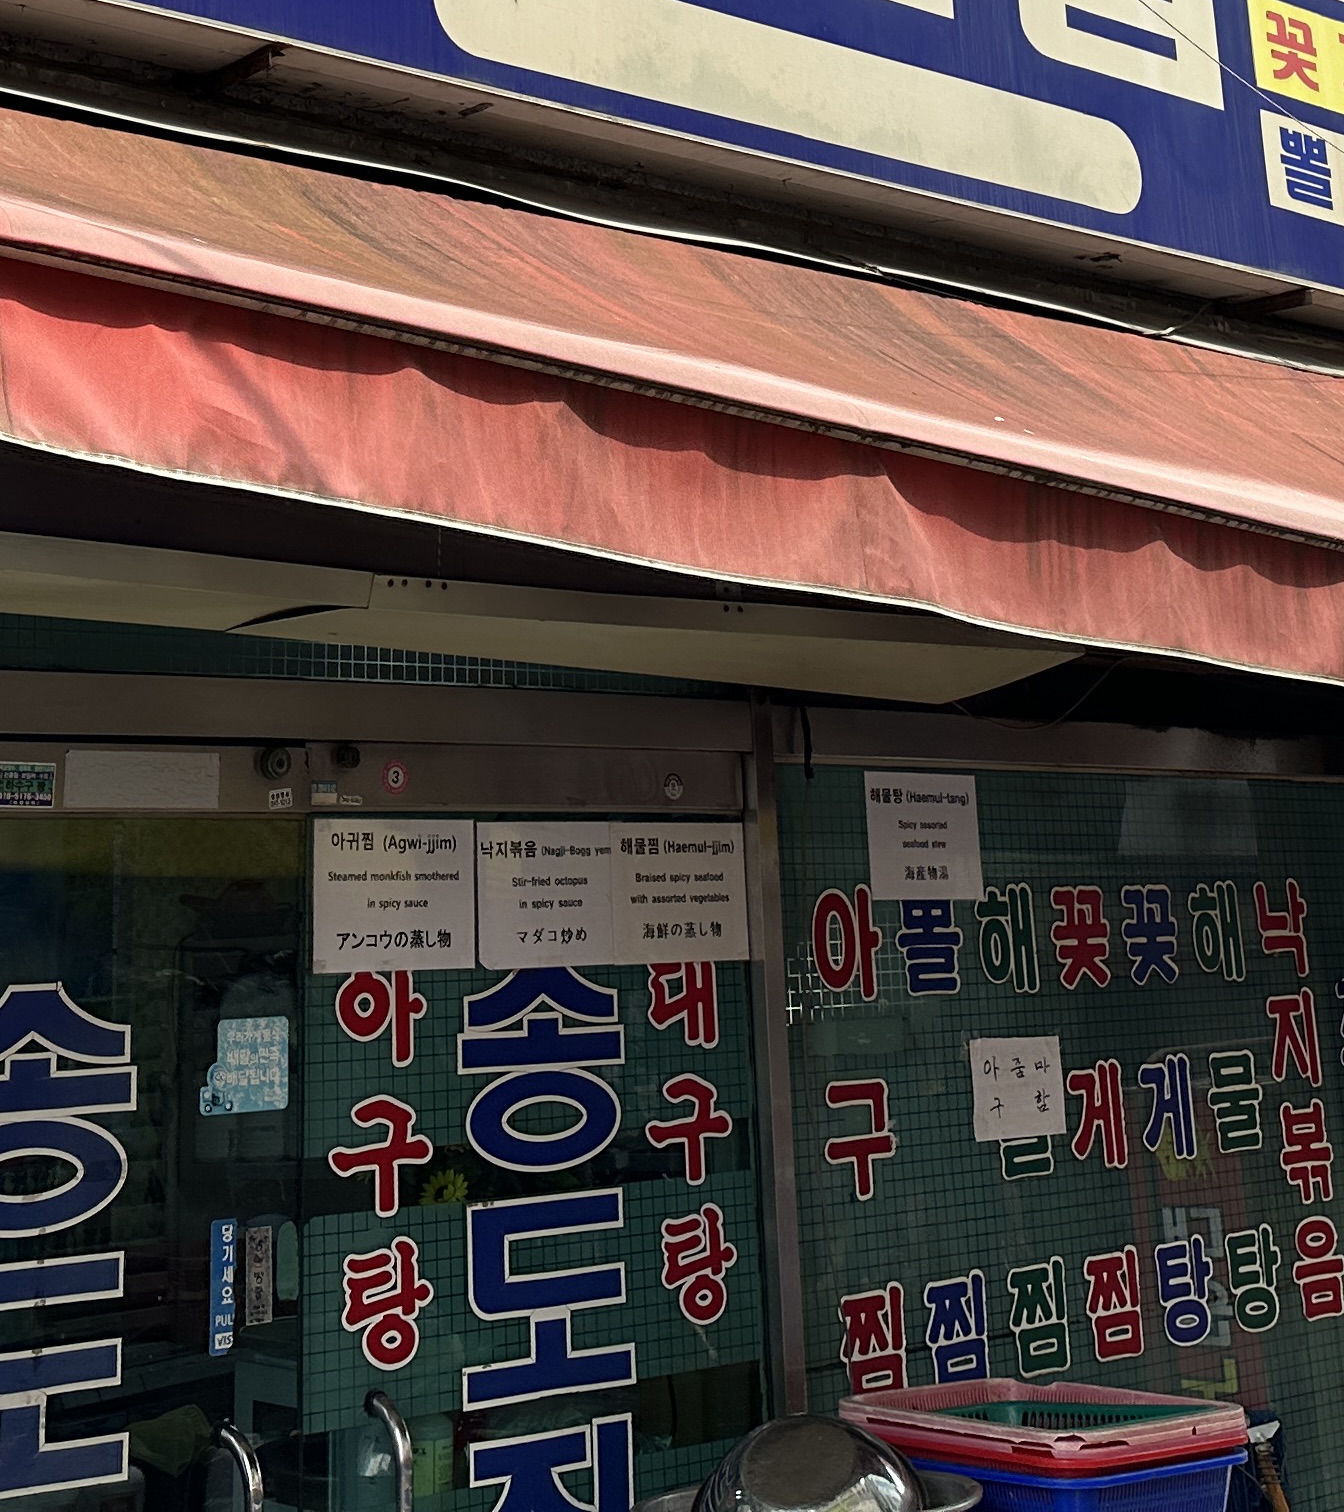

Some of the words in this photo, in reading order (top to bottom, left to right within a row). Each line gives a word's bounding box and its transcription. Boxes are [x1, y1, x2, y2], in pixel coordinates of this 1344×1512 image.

[331, 831, 374, 851] 아귀찜
[383, 834, 457, 854] (Agwi-jjim)
[480, 840, 537, 860] 낙지볶음
[620, 838, 659, 855] 해물찜
[328, 870, 367, 882] Steamed
[370, 870, 411, 882] monkfish
[414, 870, 459, 882] smothered
[378, 898, 401, 911] spicy
[405, 898, 428, 908] sauce
[531, 898, 554, 910] spicy
[336, 929, 452, 950] アンコウの蒸し物
[646, 962, 737, 1324] 대구탕
[328, 969, 433, 1371] 아구탕
[221, 1224, 234, 1305] 당기세요
[215, 1313, 235, 1328] PUL
